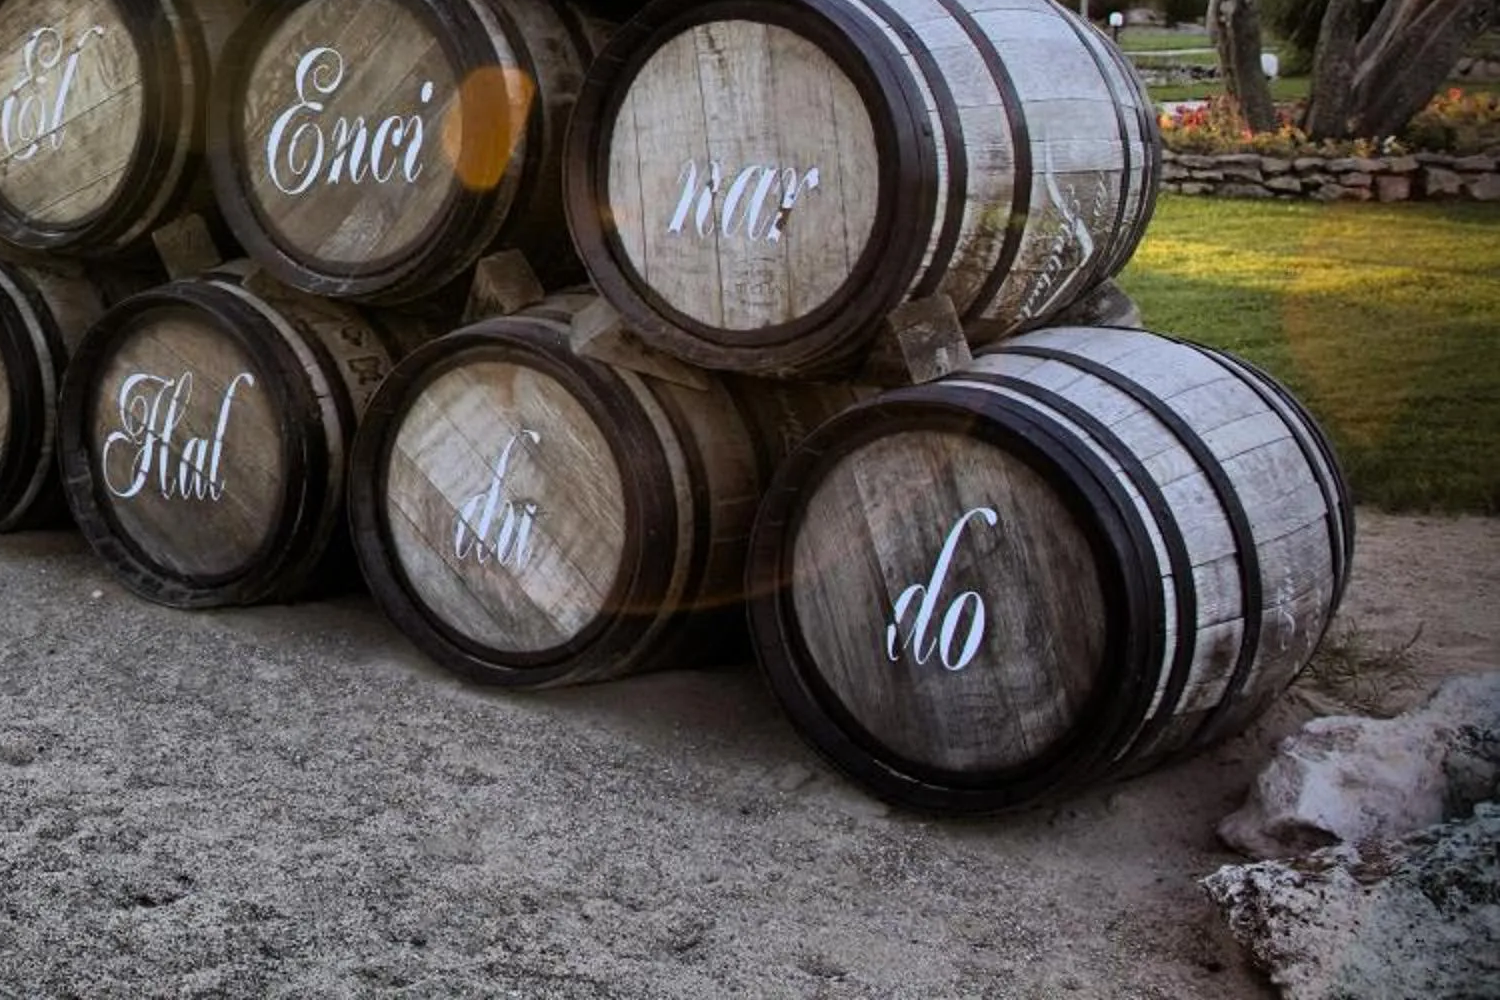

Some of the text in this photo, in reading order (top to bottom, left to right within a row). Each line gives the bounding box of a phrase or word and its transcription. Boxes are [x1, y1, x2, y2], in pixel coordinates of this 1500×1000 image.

[1, 26, 104, 162] El
[267, 46, 434, 195] Enci
[667, 159, 820, 244] nar
[102, 371, 256, 501] Hal
[886, 507, 998, 671] do
